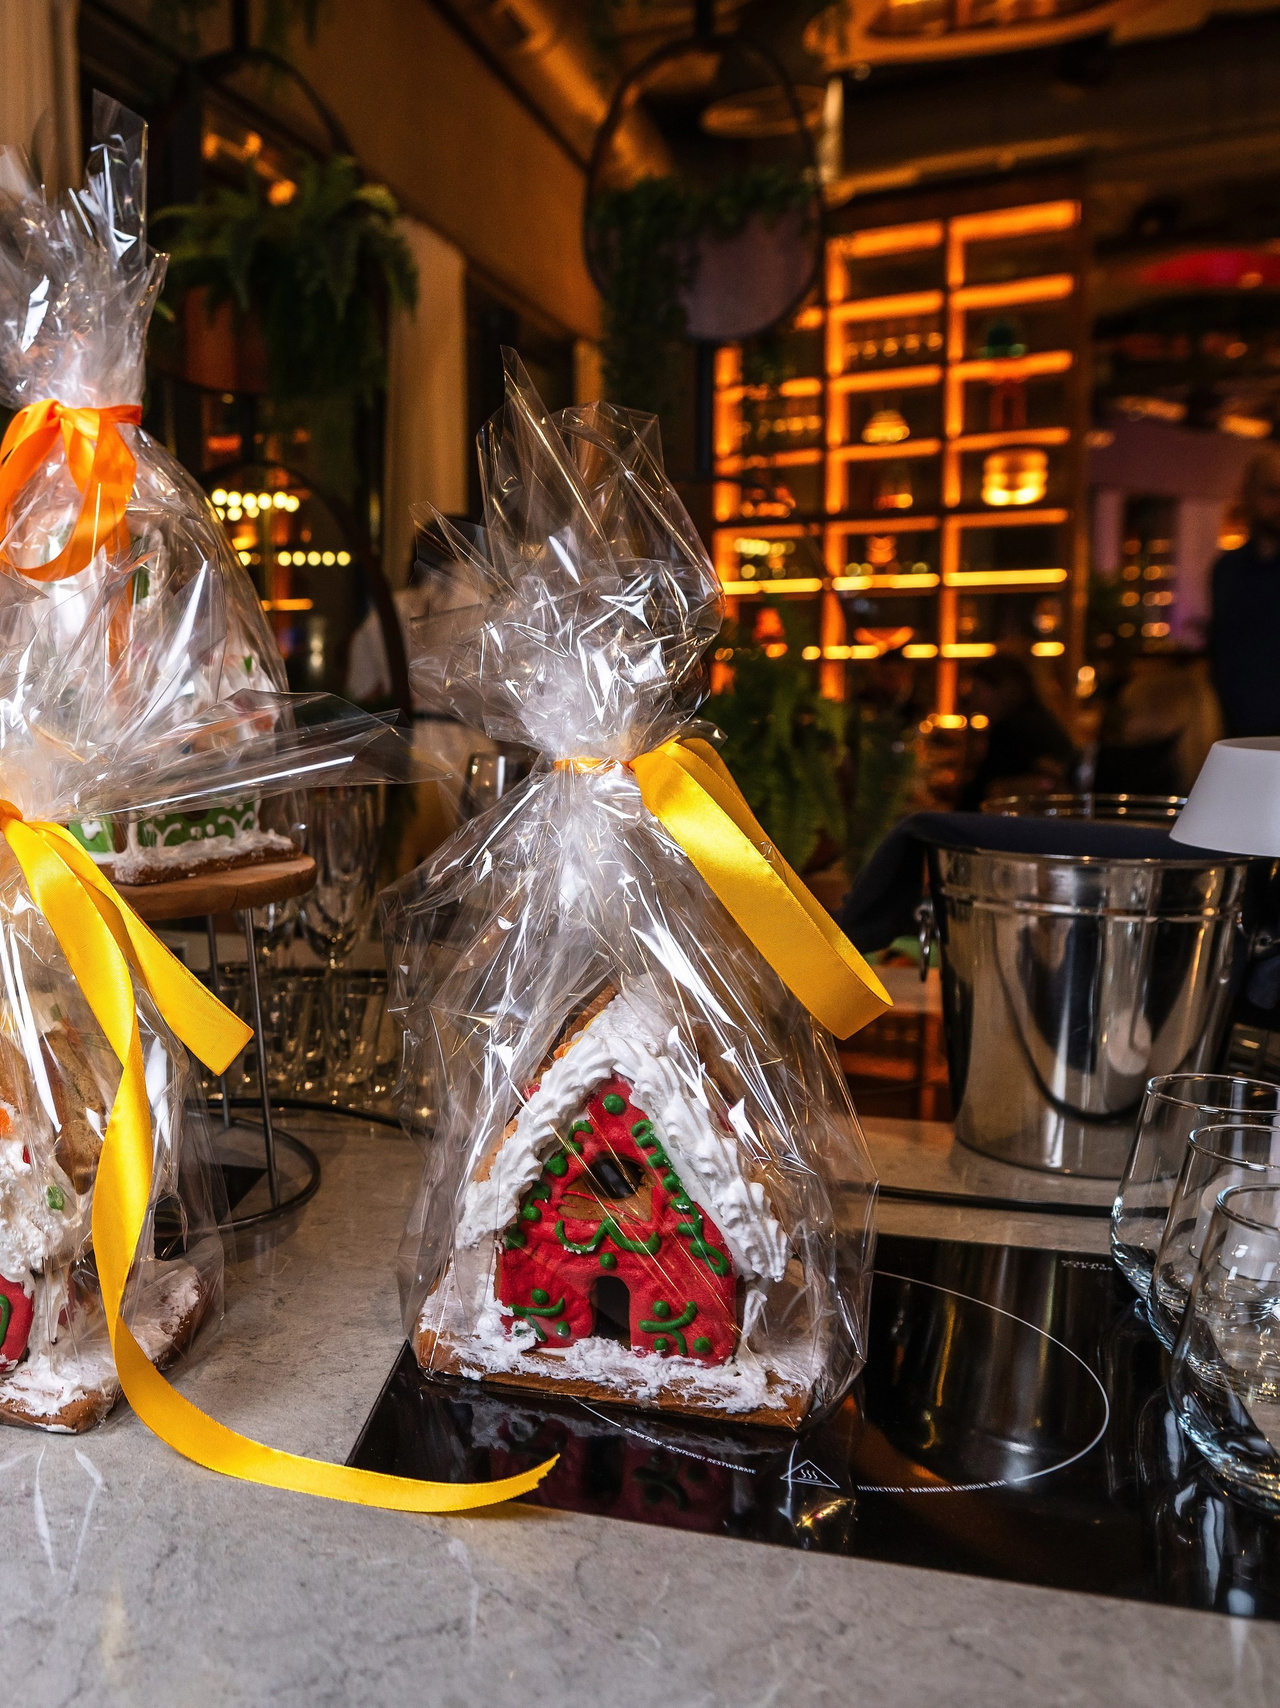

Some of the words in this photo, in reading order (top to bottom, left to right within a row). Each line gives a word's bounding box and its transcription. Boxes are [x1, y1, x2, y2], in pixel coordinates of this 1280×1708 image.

[624, 1427, 663, 1446] INDUKTION
[666, 1445, 706, 1461] ACHTUNG!
[857, 1484, 905, 1493] INDUCTION
[909, 1485, 953, 1493] WARNING!
[953, 1482, 991, 1492] RESIDUAL
